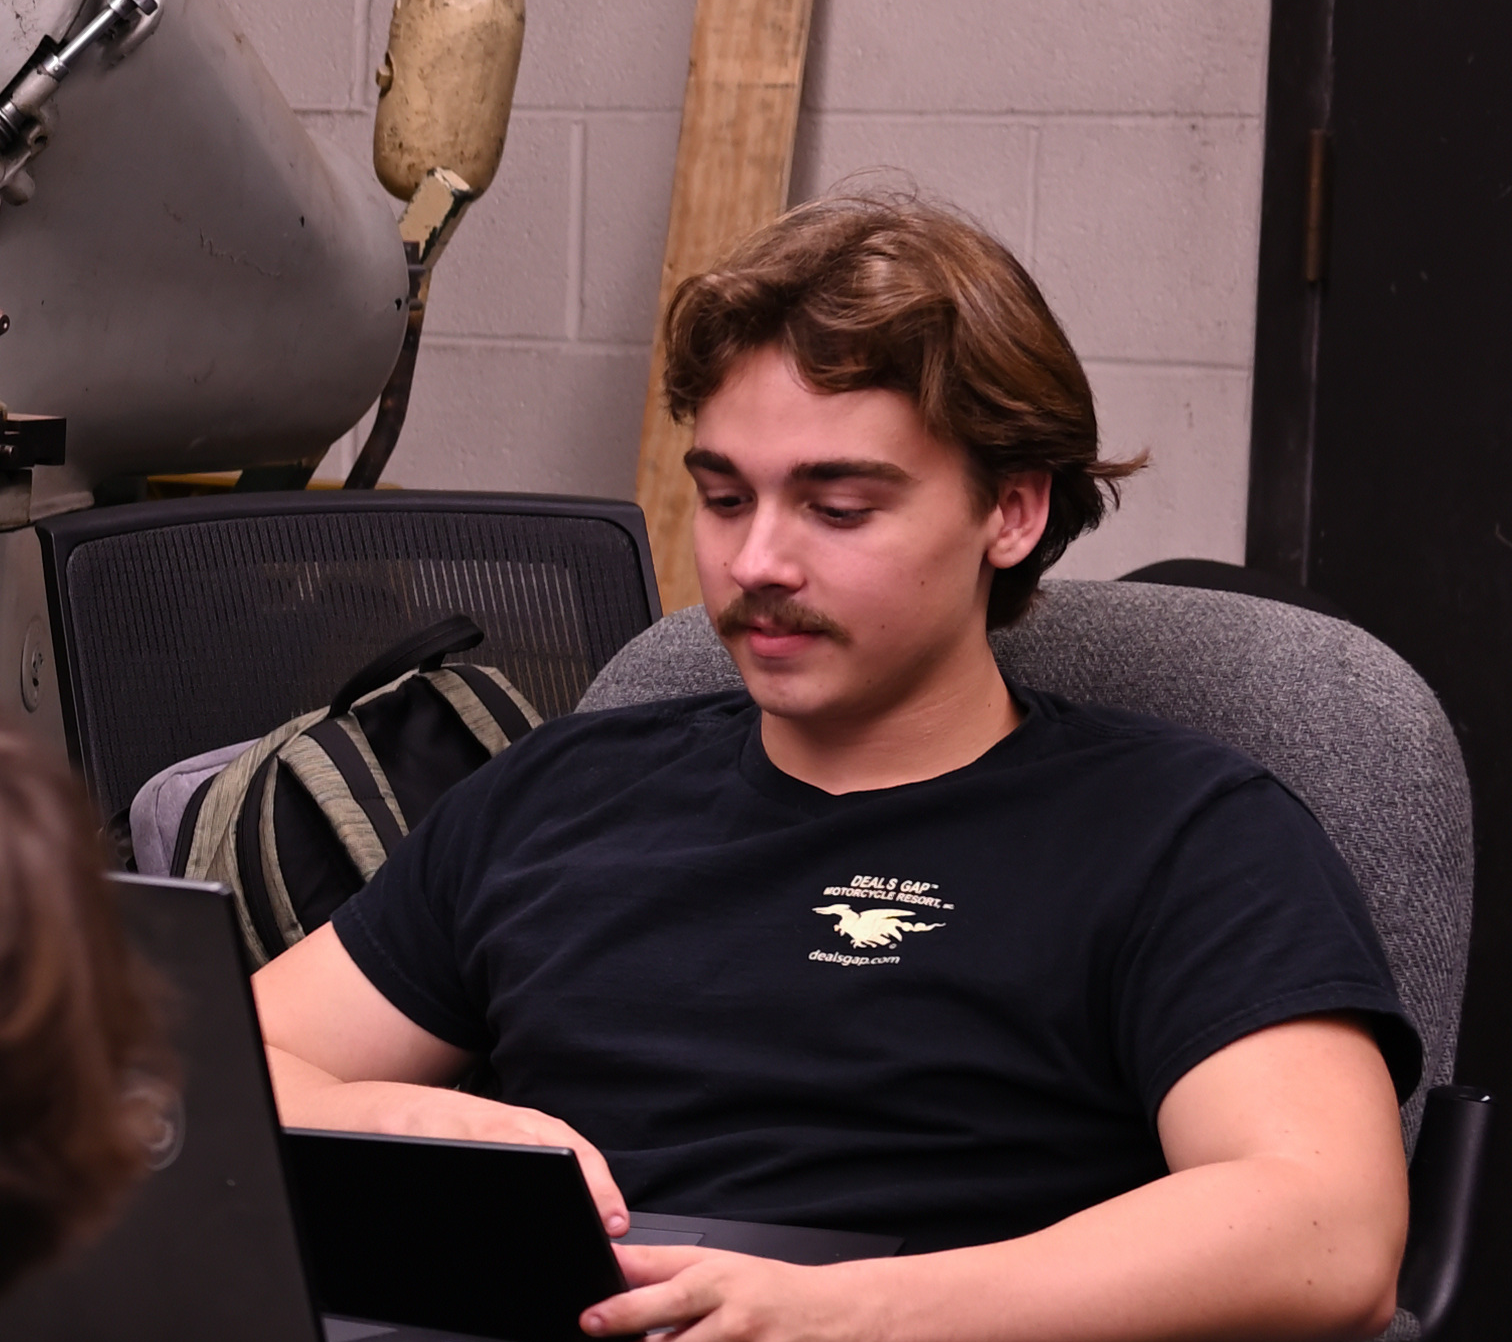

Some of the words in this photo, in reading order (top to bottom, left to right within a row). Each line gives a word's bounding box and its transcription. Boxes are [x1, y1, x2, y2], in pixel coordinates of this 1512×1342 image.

[823, 887, 896, 901] MOTORCYCLE
[900, 880, 931, 895] GAP
[808, 950, 900, 966] dealsgap.com
